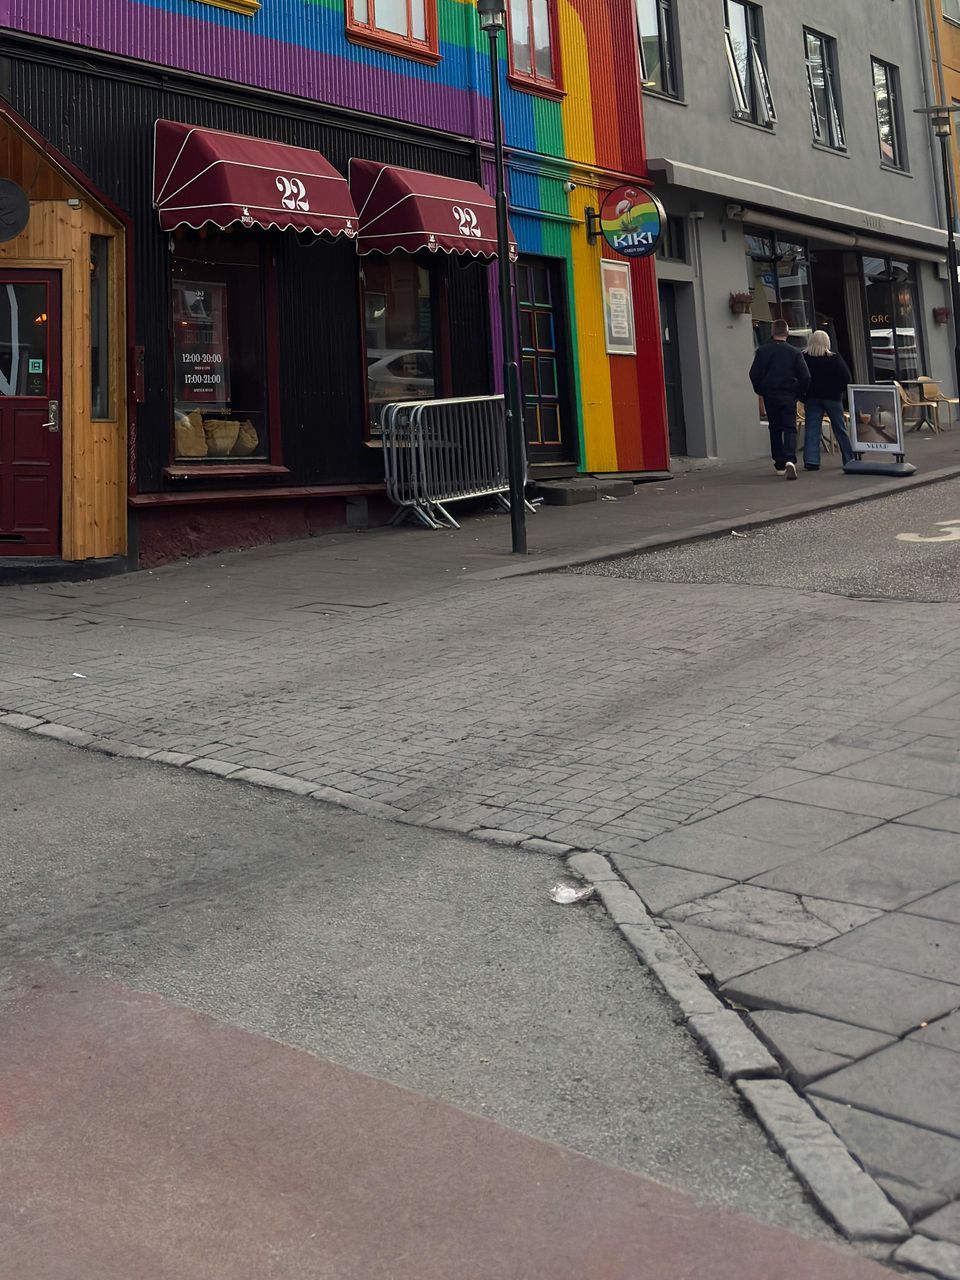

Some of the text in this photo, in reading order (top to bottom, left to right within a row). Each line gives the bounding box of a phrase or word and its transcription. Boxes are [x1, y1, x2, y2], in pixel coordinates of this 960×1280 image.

[275, 175, 310, 211] 22
[452, 206, 481, 237] 22
[613, 232, 653, 247] KIKI
[182, 353, 222, 363] 12:00-20:00
[184, 374, 221, 384] 17:00-21:00
